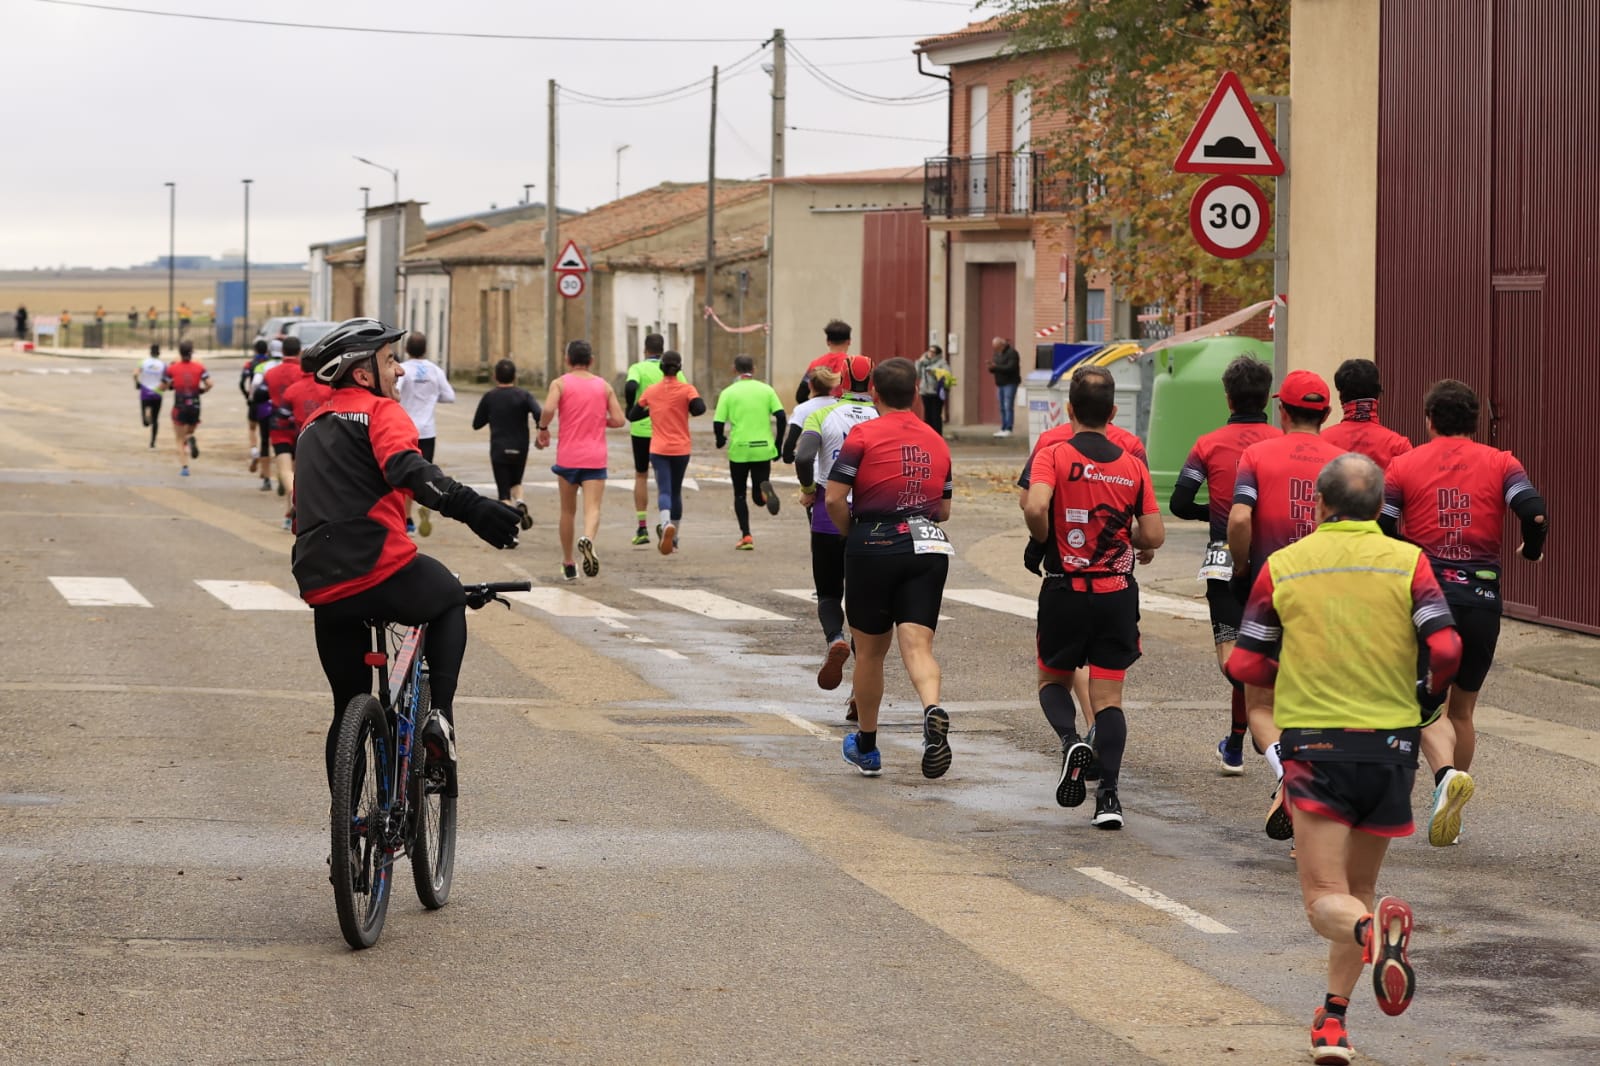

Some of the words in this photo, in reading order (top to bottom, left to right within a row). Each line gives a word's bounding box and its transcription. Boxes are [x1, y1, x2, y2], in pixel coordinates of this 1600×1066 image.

[1209, 203, 1251, 229] 30
[563, 280, 578, 290] 30
[902, 461, 931, 480] bre
[1437, 487, 1470, 511] DCa
[1438, 509, 1471, 528] bre
[918, 526, 944, 541] 320
[1445, 528, 1463, 546] ri
